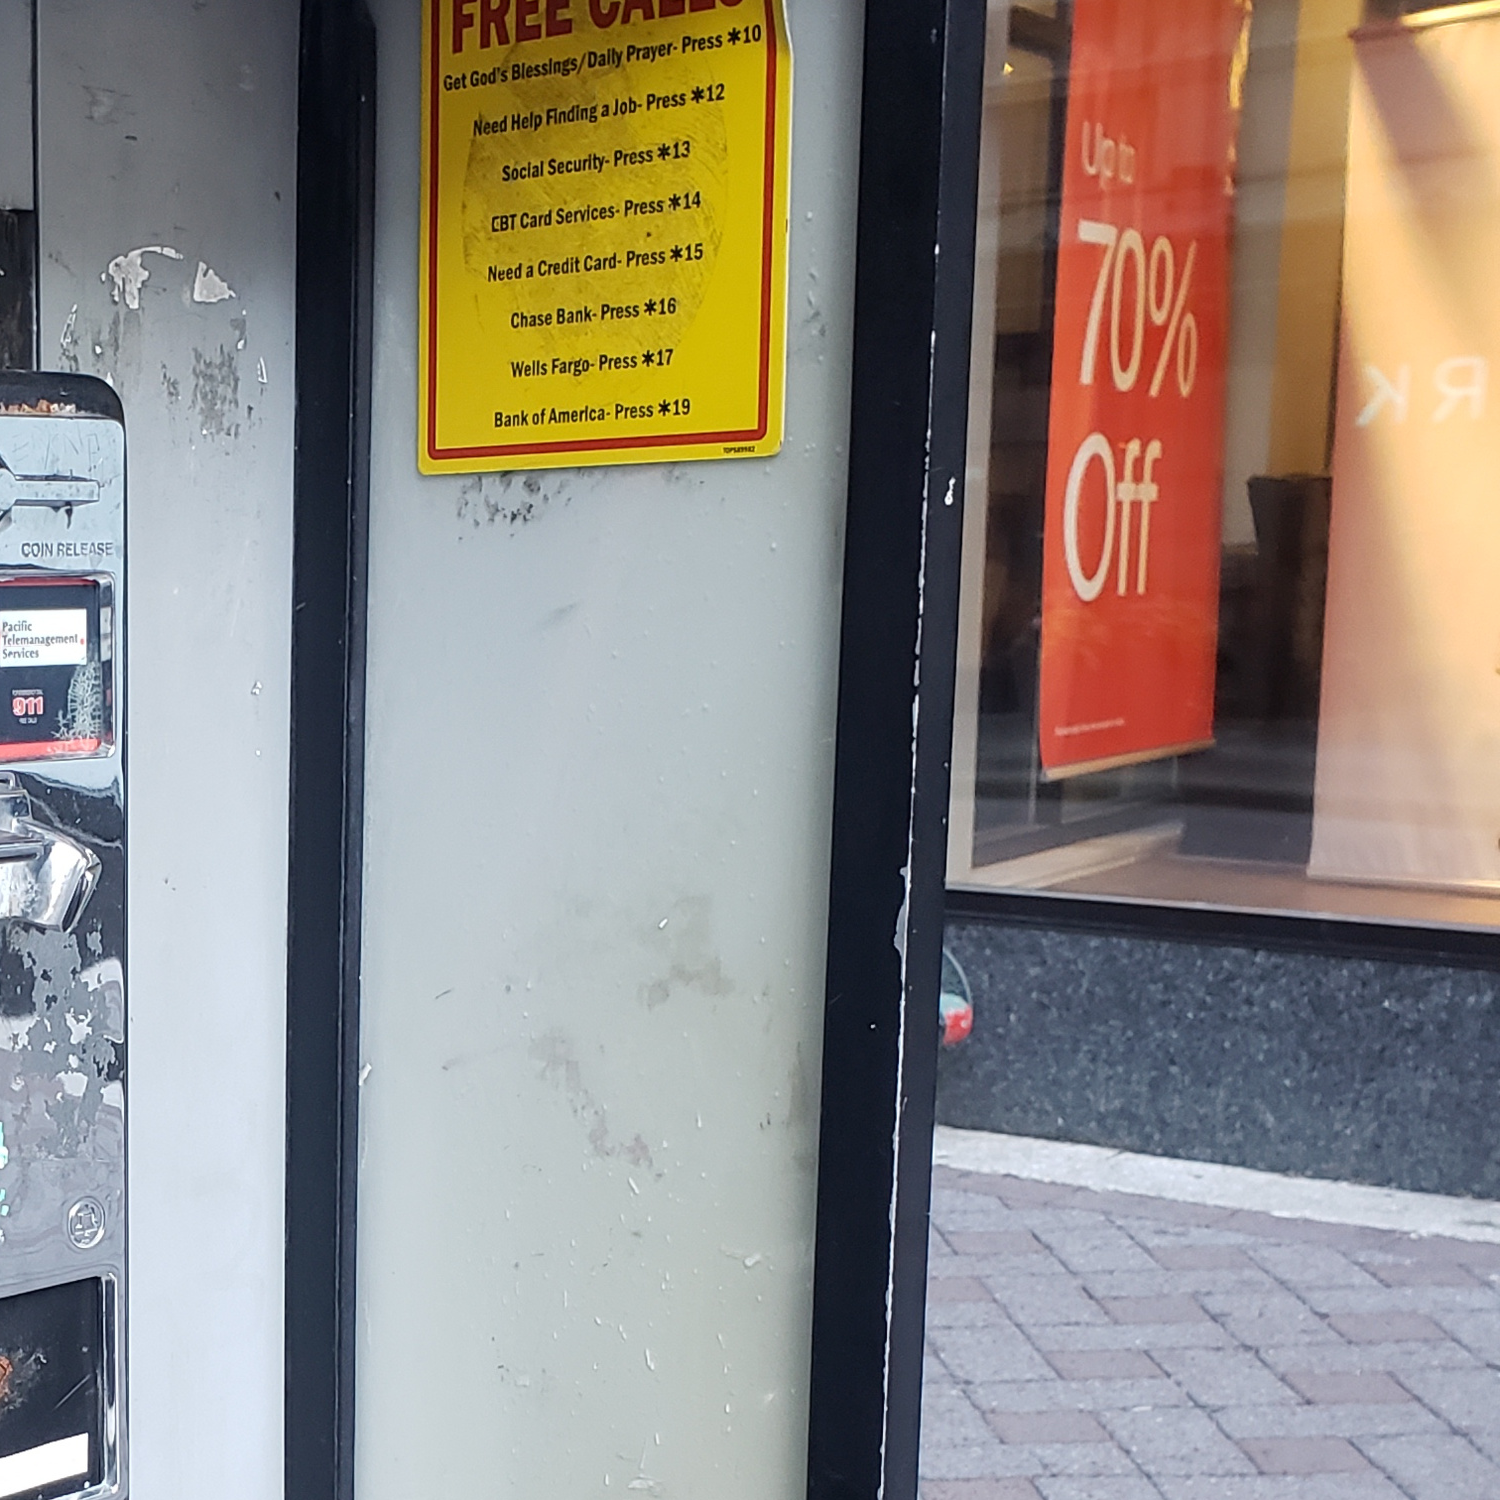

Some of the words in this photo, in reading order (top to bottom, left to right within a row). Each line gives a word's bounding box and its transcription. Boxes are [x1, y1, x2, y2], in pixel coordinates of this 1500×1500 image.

[444, 74, 468, 91] Get
[470, 66, 508, 87] God's
[627, 42, 678, 62] Prayer-
[682, 33, 723, 54] Press
[473, 117, 508, 137] Need
[511, 110, 543, 132] Help
[546, 102, 598, 127] Finding
[600, 104, 610, 118] a
[612, 96, 643, 117] Job-
[646, 90, 687, 111] Press
[502, 156, 545, 182] Social
[547, 149, 610, 176] Security-
[613, 146, 654, 168] Press
[520, 207, 553, 230] Card
[555, 201, 621, 227] Services-
[624, 197, 664, 217] Press
[488, 264, 522, 283] Need
[526, 265, 534, 279] a
[537, 255, 581, 278] Credit
[583, 251, 623, 273] Card-
[626, 247, 666, 268] Press
[510, 310, 553, 329] Chase
[556, 305, 598, 325] Bank-
[601, 301, 640, 322] Press
[1077, 221, 1198, 398] 70%
[511, 358, 548, 379] Wells
[551, 355, 596, 378] Fargo-
[598, 351, 638, 371] Press
[494, 408, 529, 429] Bank
[532, 407, 546, 425] of
[547, 404, 611, 425] America-
[615, 401, 655, 421] Press
[1063, 432, 1162, 602] Off
[21, 541, 54, 558] COIN
[57, 541, 114, 557] RELEASE
[2, 620, 32, 632] Pacific
[2, 633, 78, 647] Telemanagement
[2, 648, 39, 659] Services
[12, 696, 44, 716] 911
